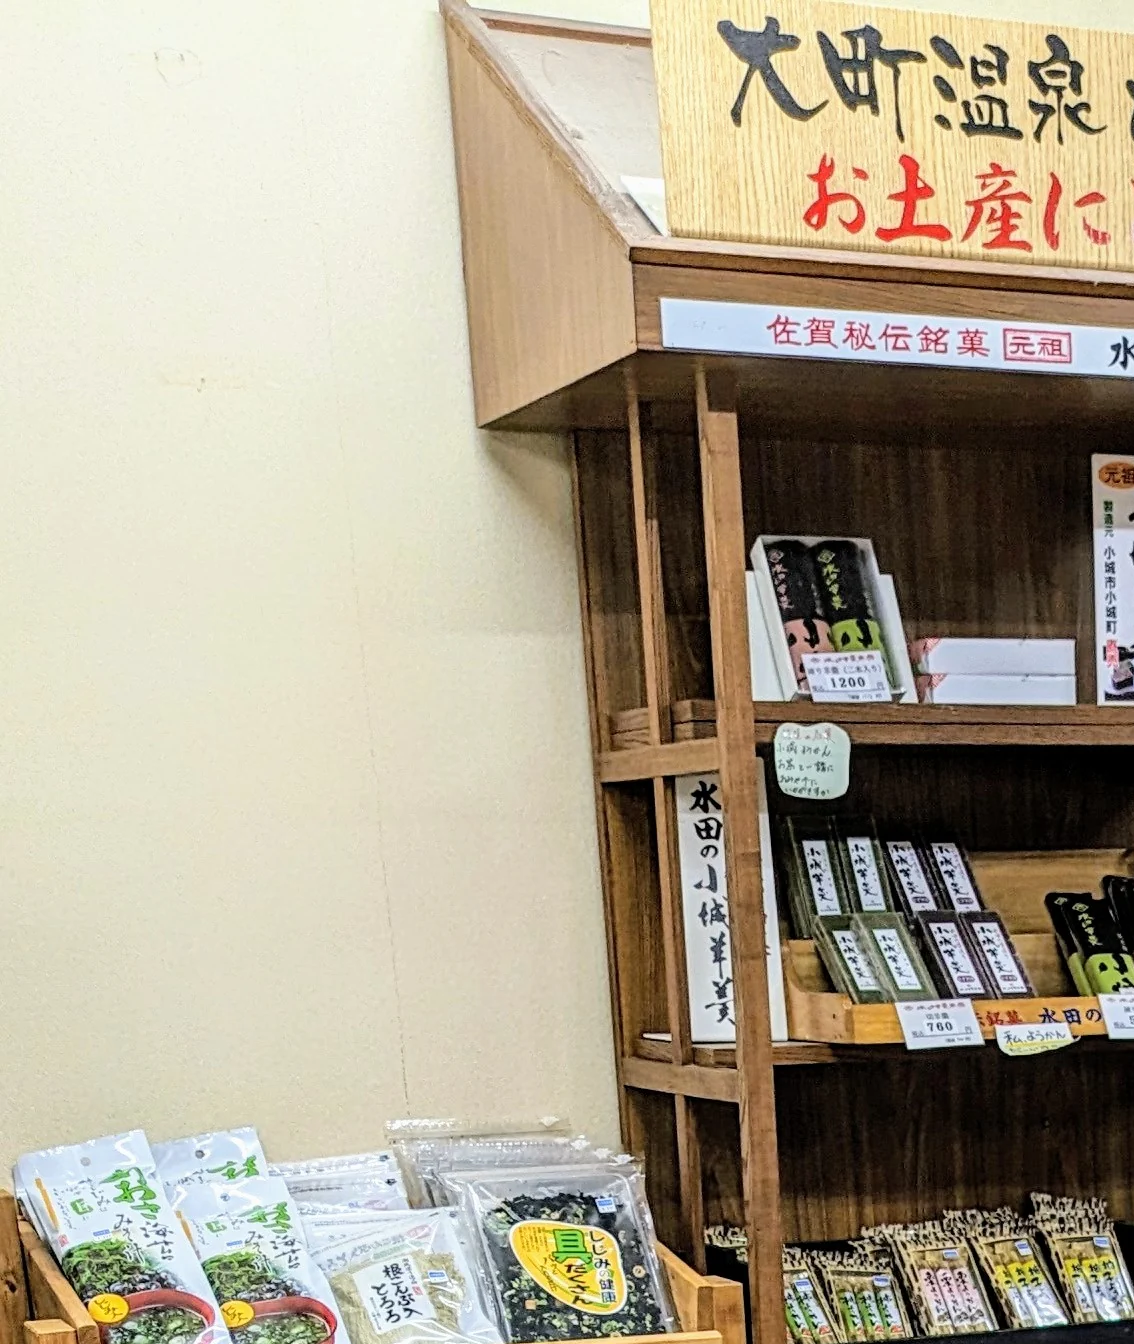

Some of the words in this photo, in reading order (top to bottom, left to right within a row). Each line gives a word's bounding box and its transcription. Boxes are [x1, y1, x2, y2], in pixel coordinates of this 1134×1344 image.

[717, 15, 1106, 146] 大町温泉
[766, 315, 991, 359] 佐賀秘伝銘菓
[1008, 332, 1067, 363] 元祖
[830, 677, 866, 689] 1200
[926, 1020, 953, 1033] 760
[371, 1284, 401, 1324] とろろ
